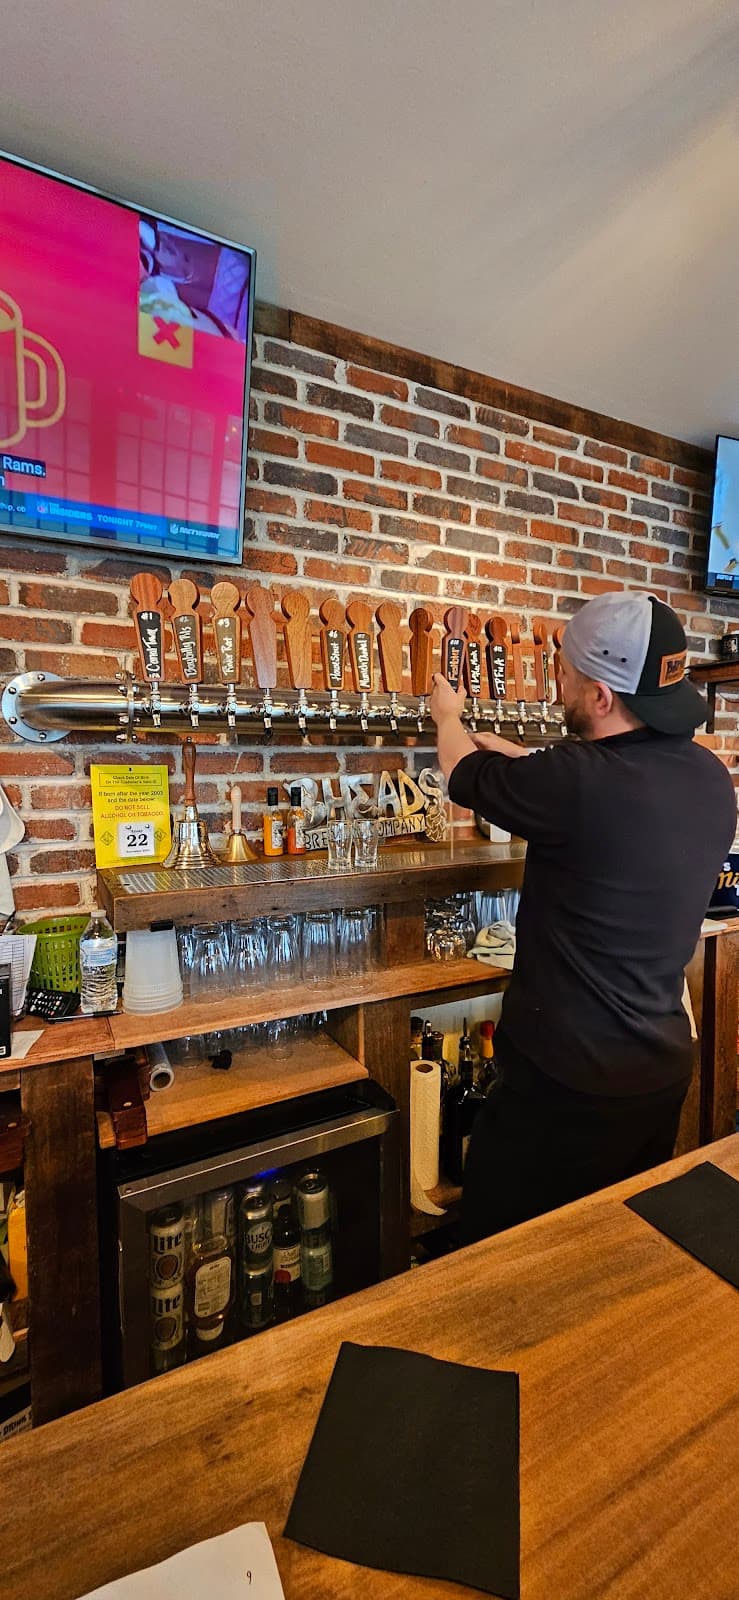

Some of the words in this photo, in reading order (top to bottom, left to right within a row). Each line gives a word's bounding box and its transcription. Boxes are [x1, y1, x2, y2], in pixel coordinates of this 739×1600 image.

[2, 456, 46, 477] Rams.
[97, 514, 134, 528] TONIGHT
[127, 833, 148, 848] 22
